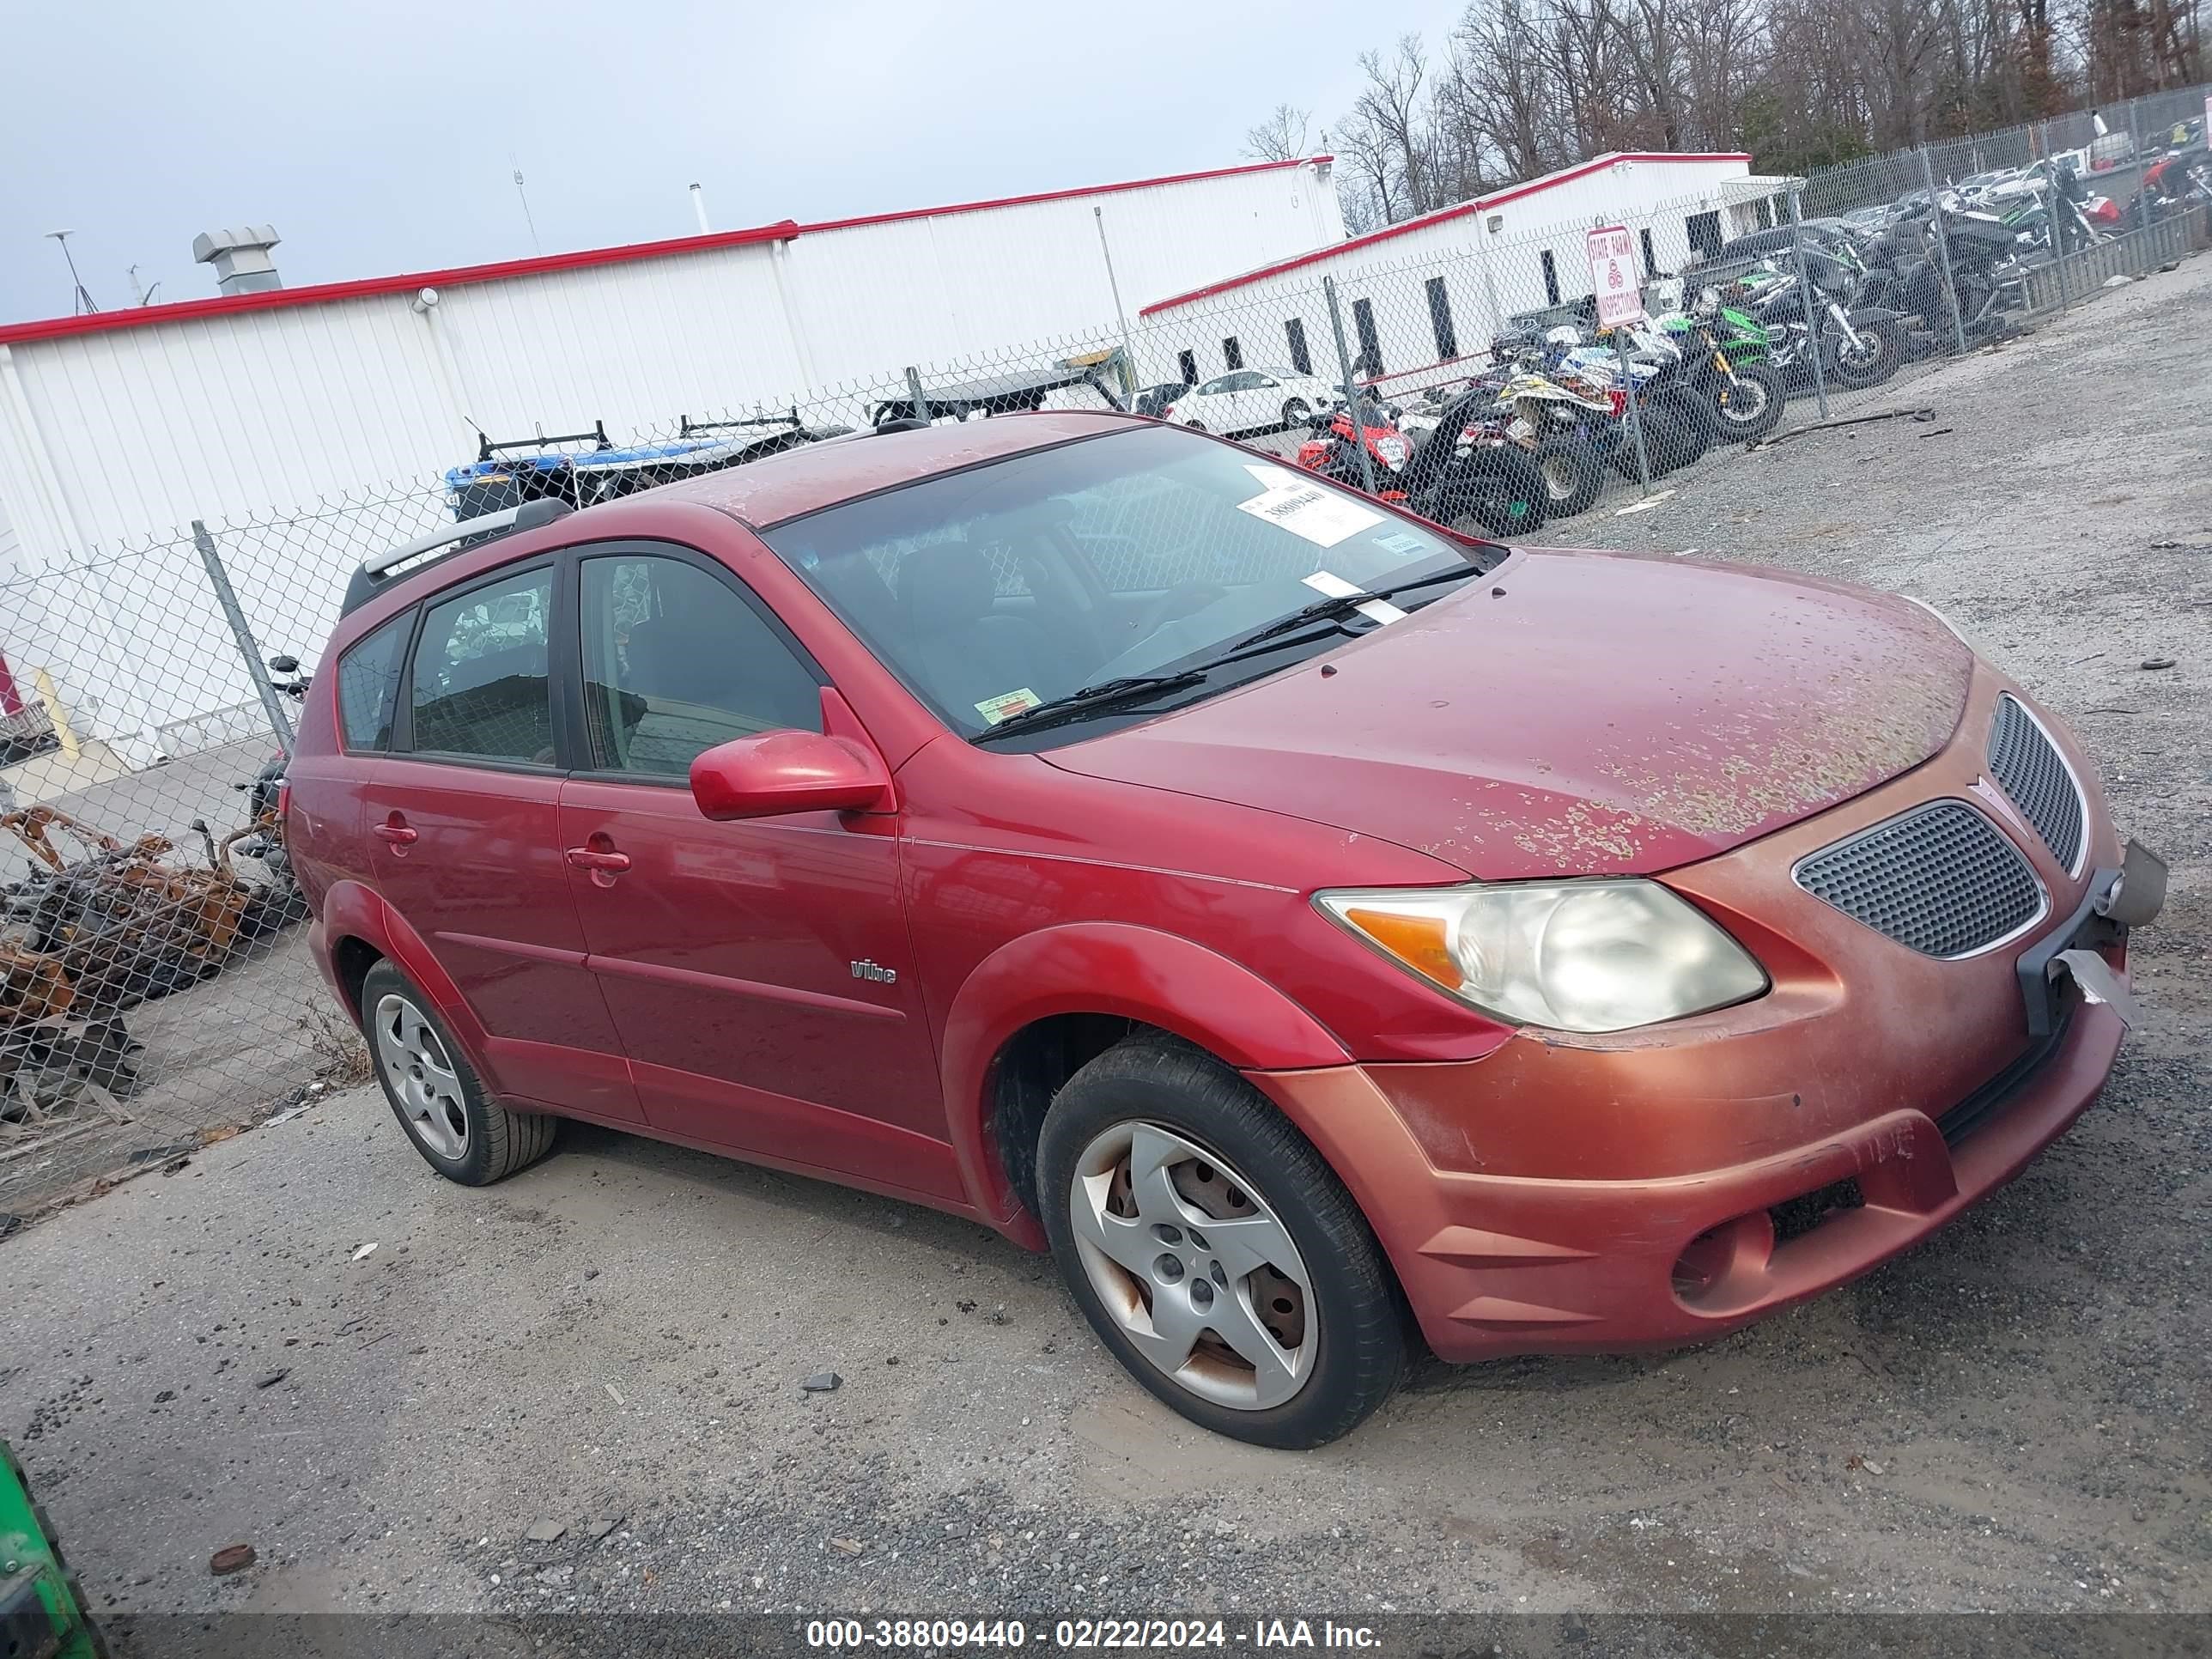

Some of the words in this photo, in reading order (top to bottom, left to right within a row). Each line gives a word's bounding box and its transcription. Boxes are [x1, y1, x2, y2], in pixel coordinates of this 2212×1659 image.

[1590, 237, 1609, 261] STATE
[1611, 234, 1630, 257] FARM
[1600, 289, 1639, 318] INSPECTIONS
[1264, 490, 1326, 520] 38809440
